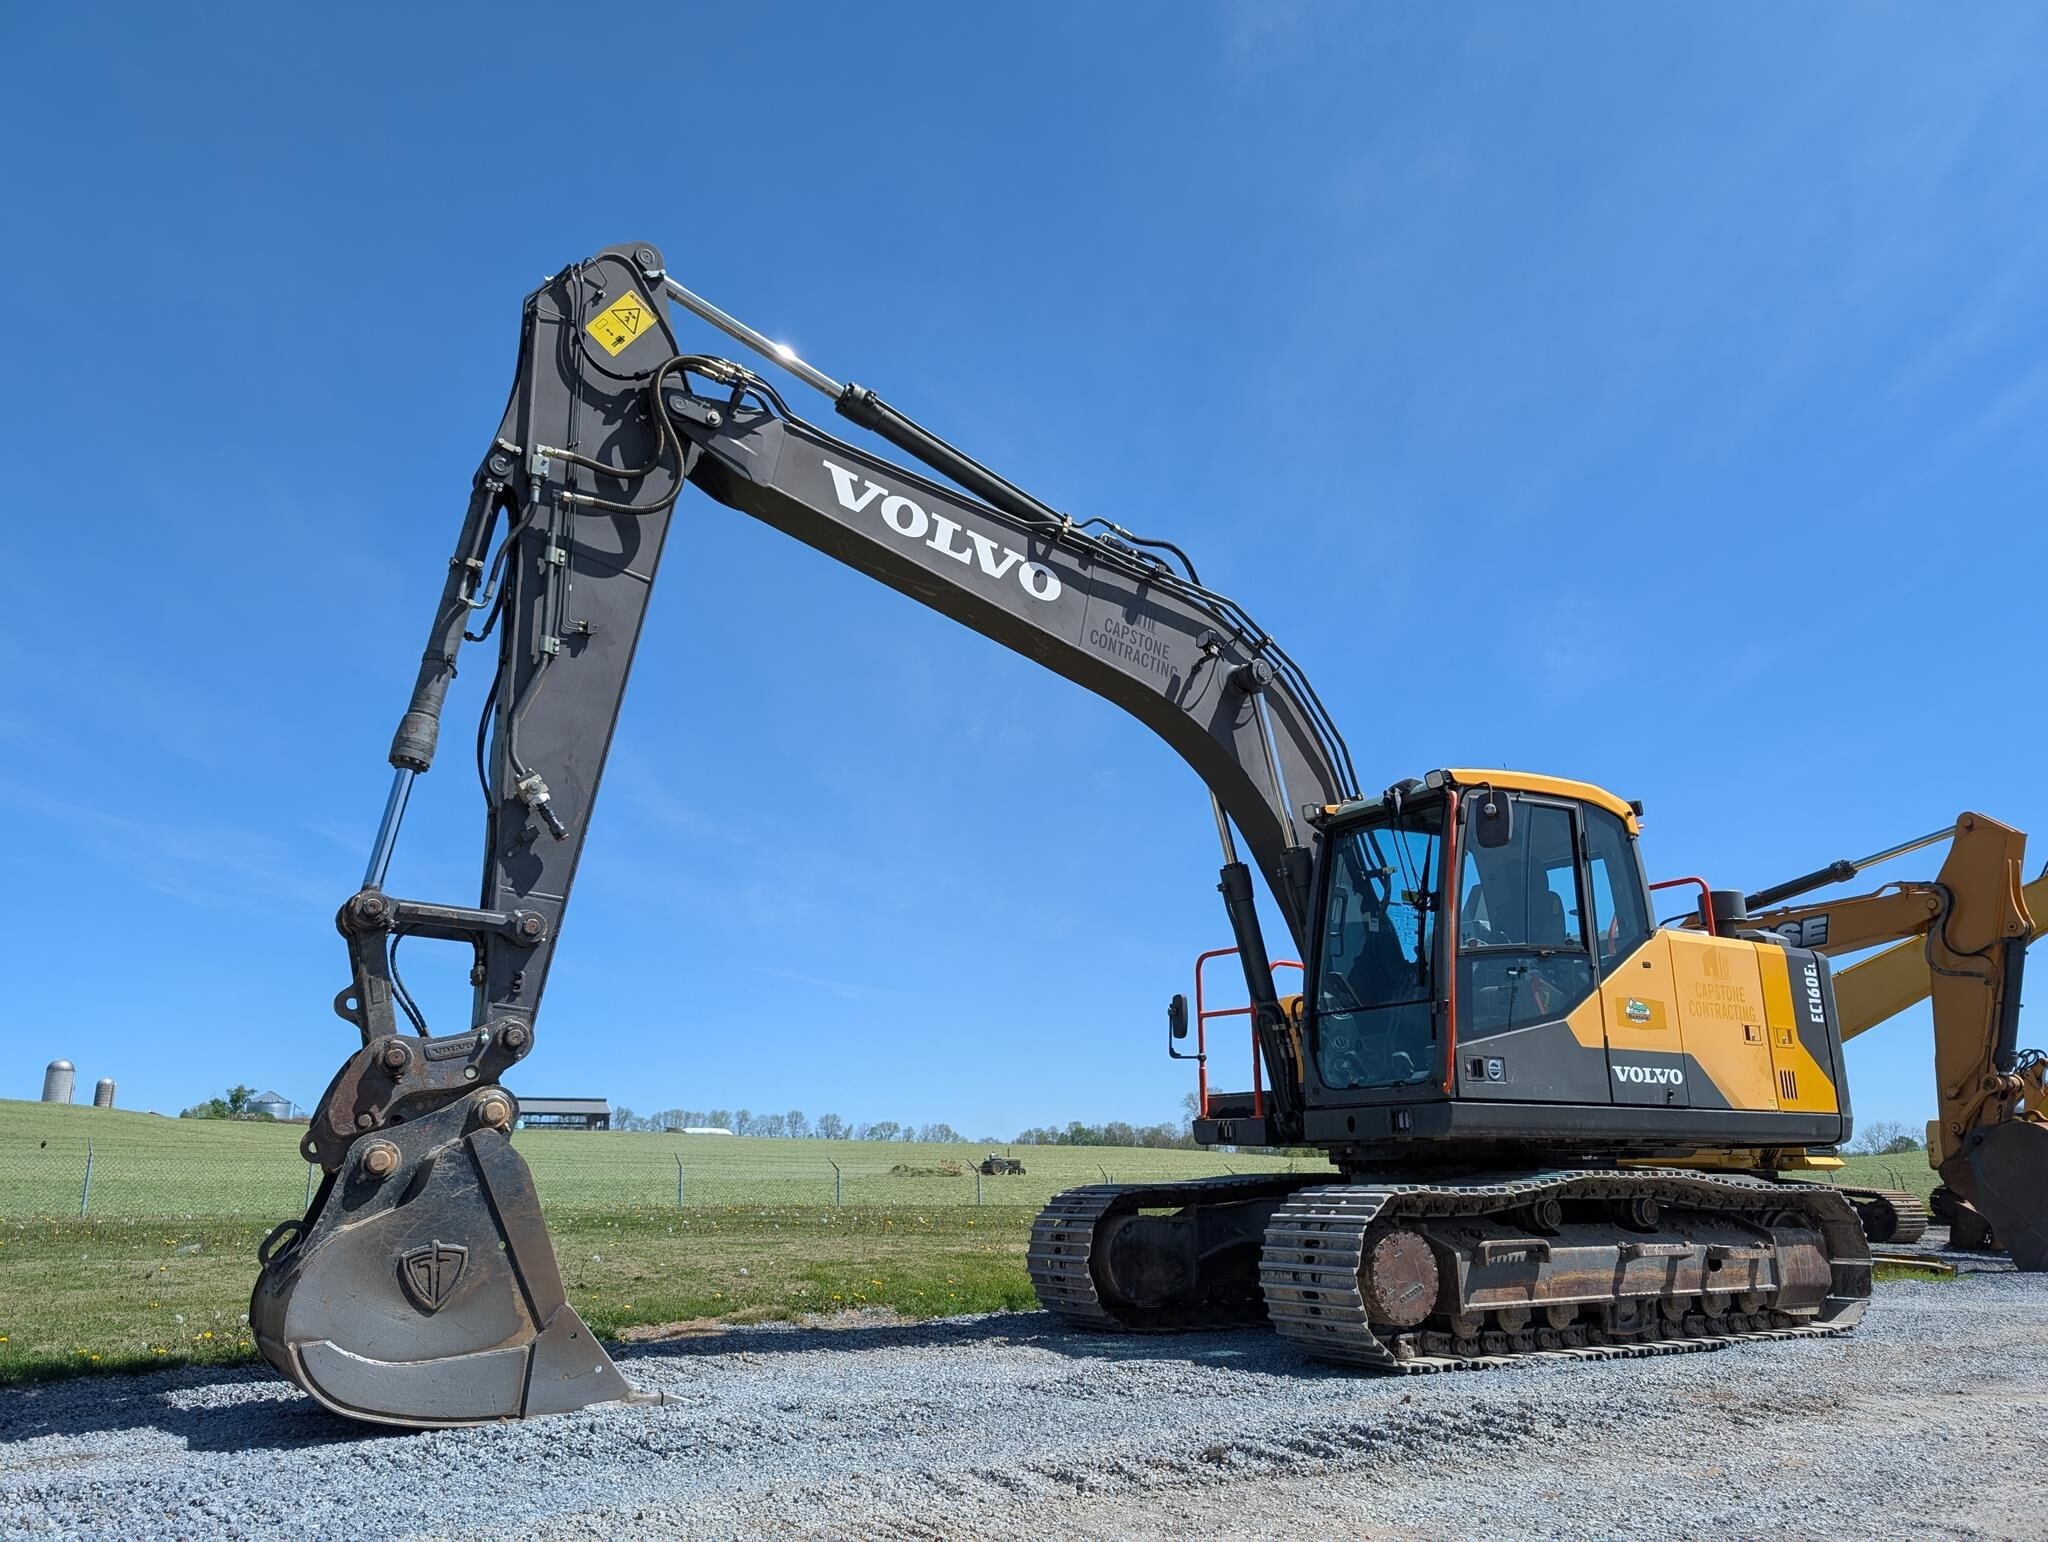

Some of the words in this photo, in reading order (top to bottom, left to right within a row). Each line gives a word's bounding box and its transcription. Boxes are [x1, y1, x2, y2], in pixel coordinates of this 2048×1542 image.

[822, 459, 1063, 602] VOLVO
[1104, 617, 1171, 661] CAPSTONE
[1758, 914, 1828, 948] SE
[1695, 982, 1746, 1003] CAPSTONE
[1689, 1000, 1756, 1022] CONTRACTING
[1612, 1065, 1683, 1085] VOLVO
